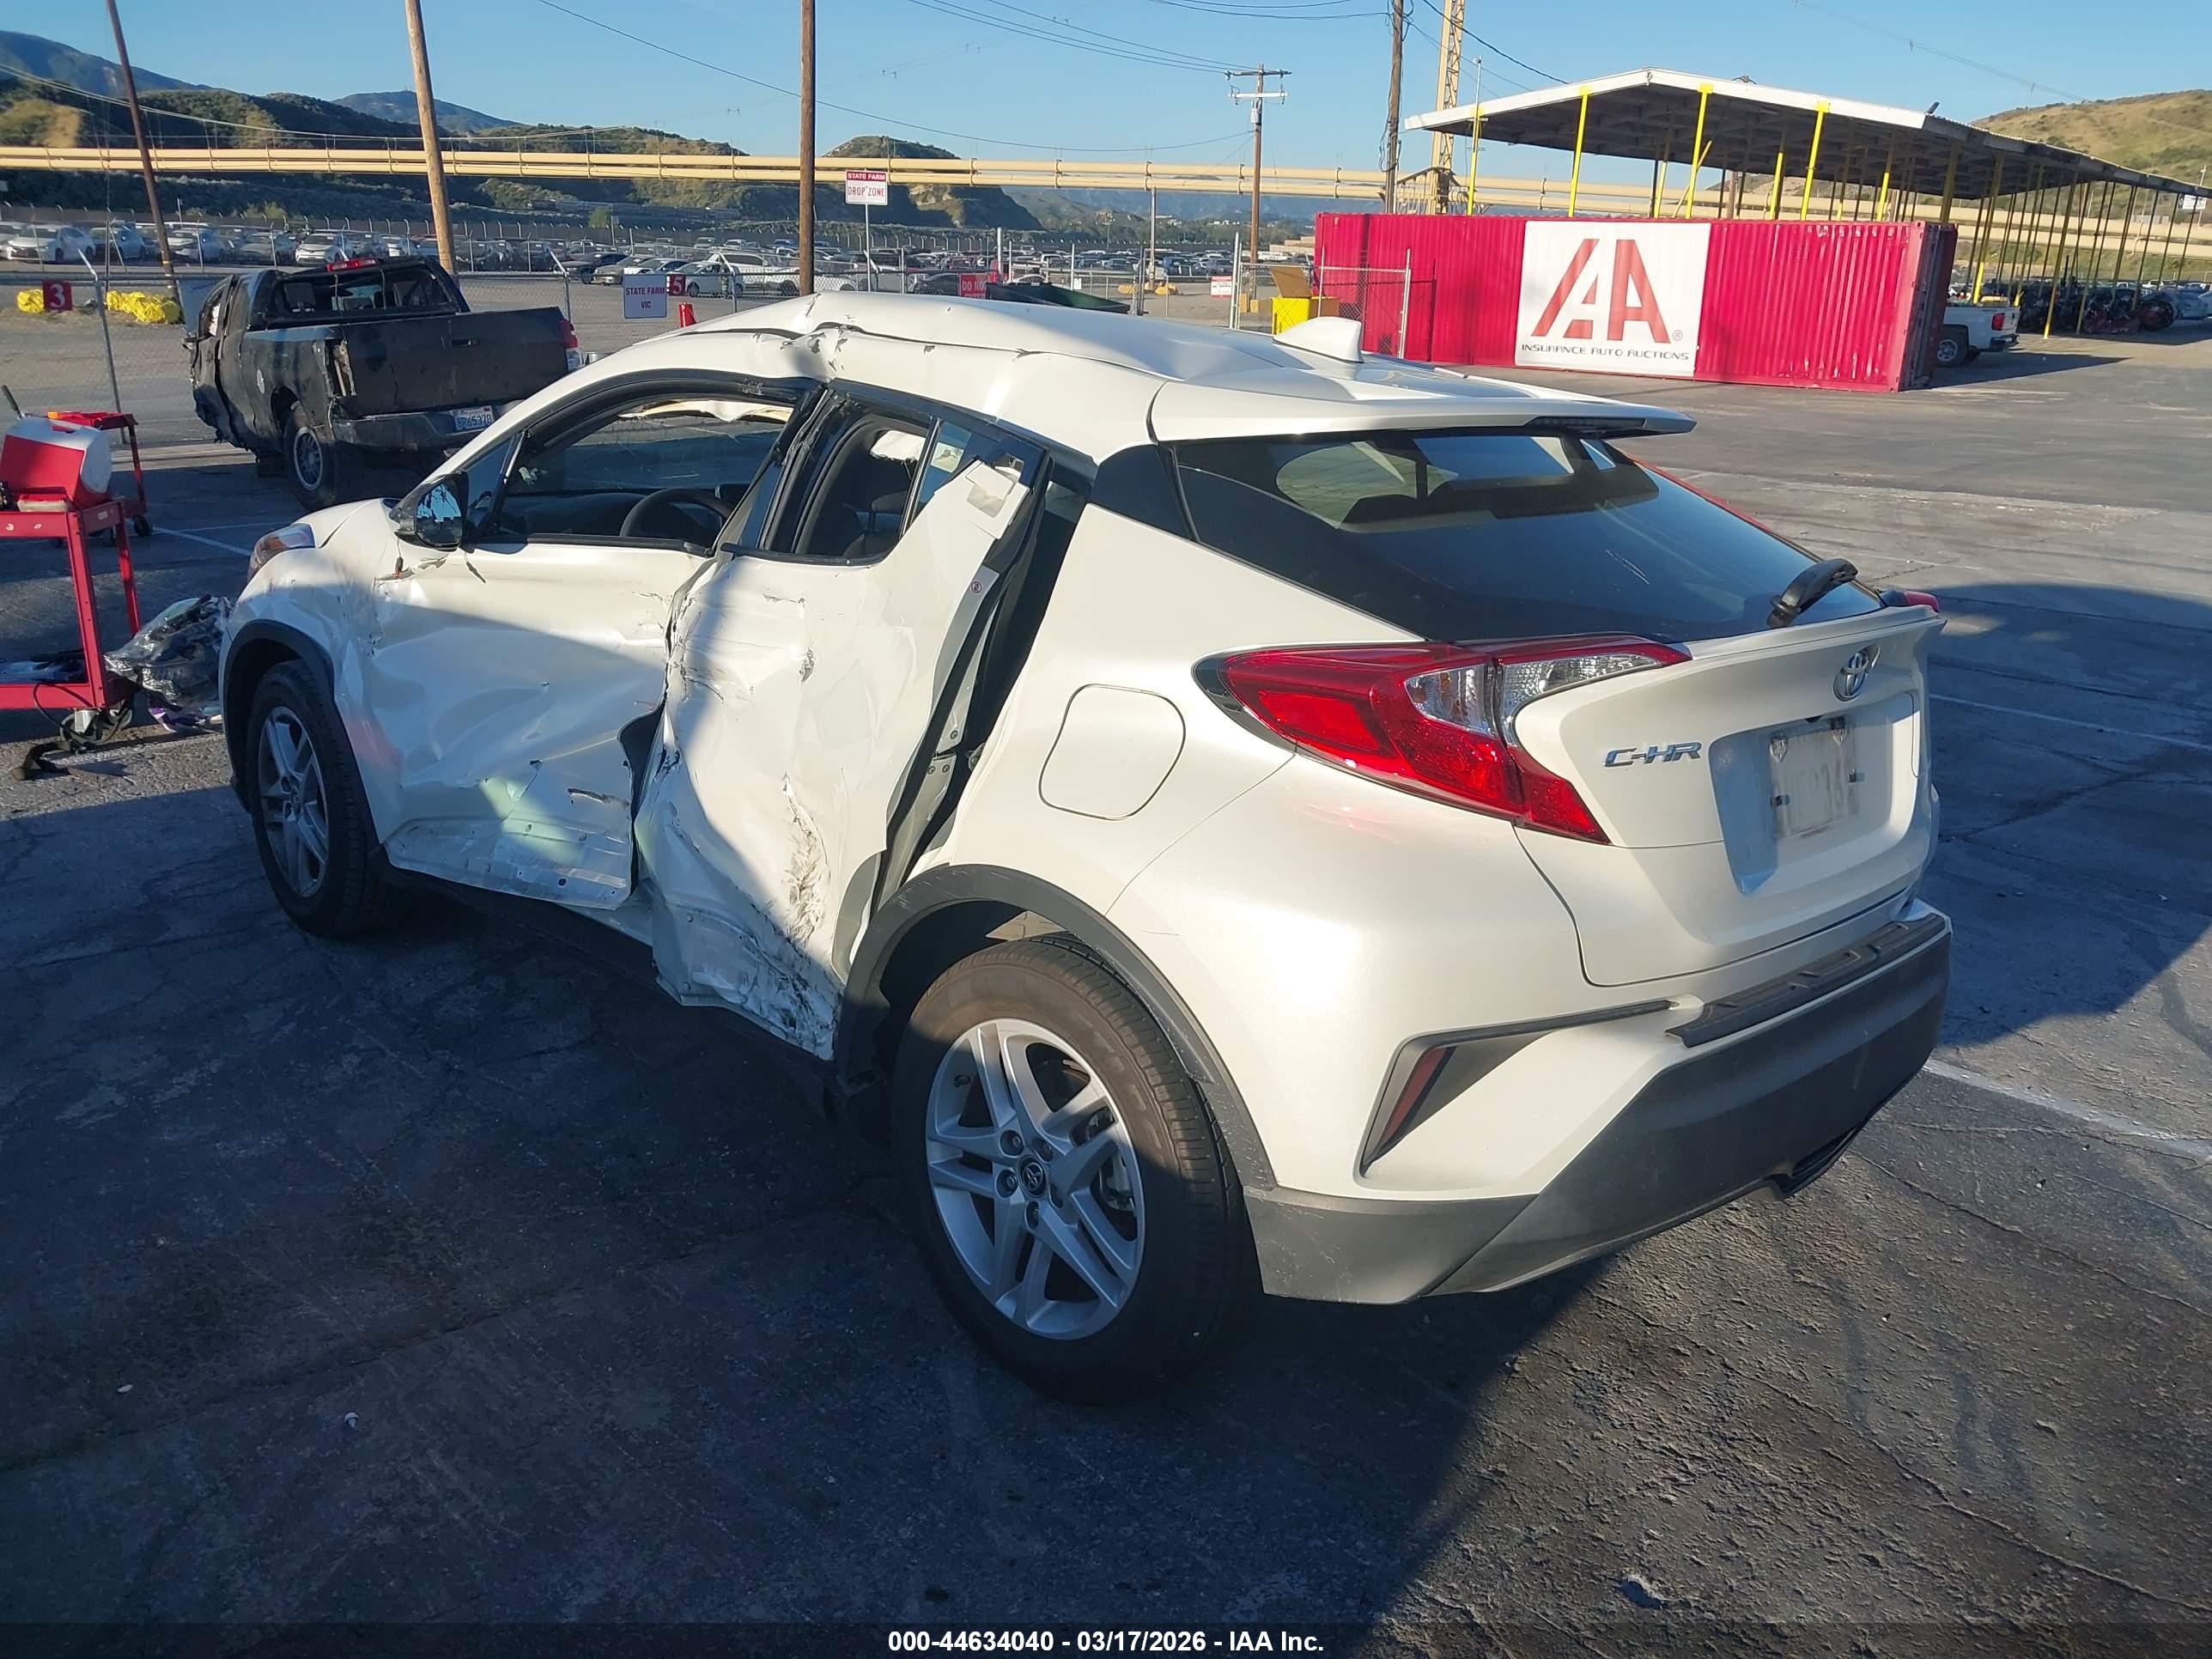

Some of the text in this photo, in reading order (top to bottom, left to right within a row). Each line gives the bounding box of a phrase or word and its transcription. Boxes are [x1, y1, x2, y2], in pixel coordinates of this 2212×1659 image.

[848, 185, 885, 198] DROP ZONE
[625, 286, 665, 296] STATE FARM
[672, 275, 684, 295] 5
[962, 281, 972, 291] DO
[50, 283, 65, 308] 3
[640, 300, 653, 310] VIC
[1522, 343, 1689, 361] INSURANCE AUTO AUCTIONS
[1604, 741, 1702, 768] C-HR
